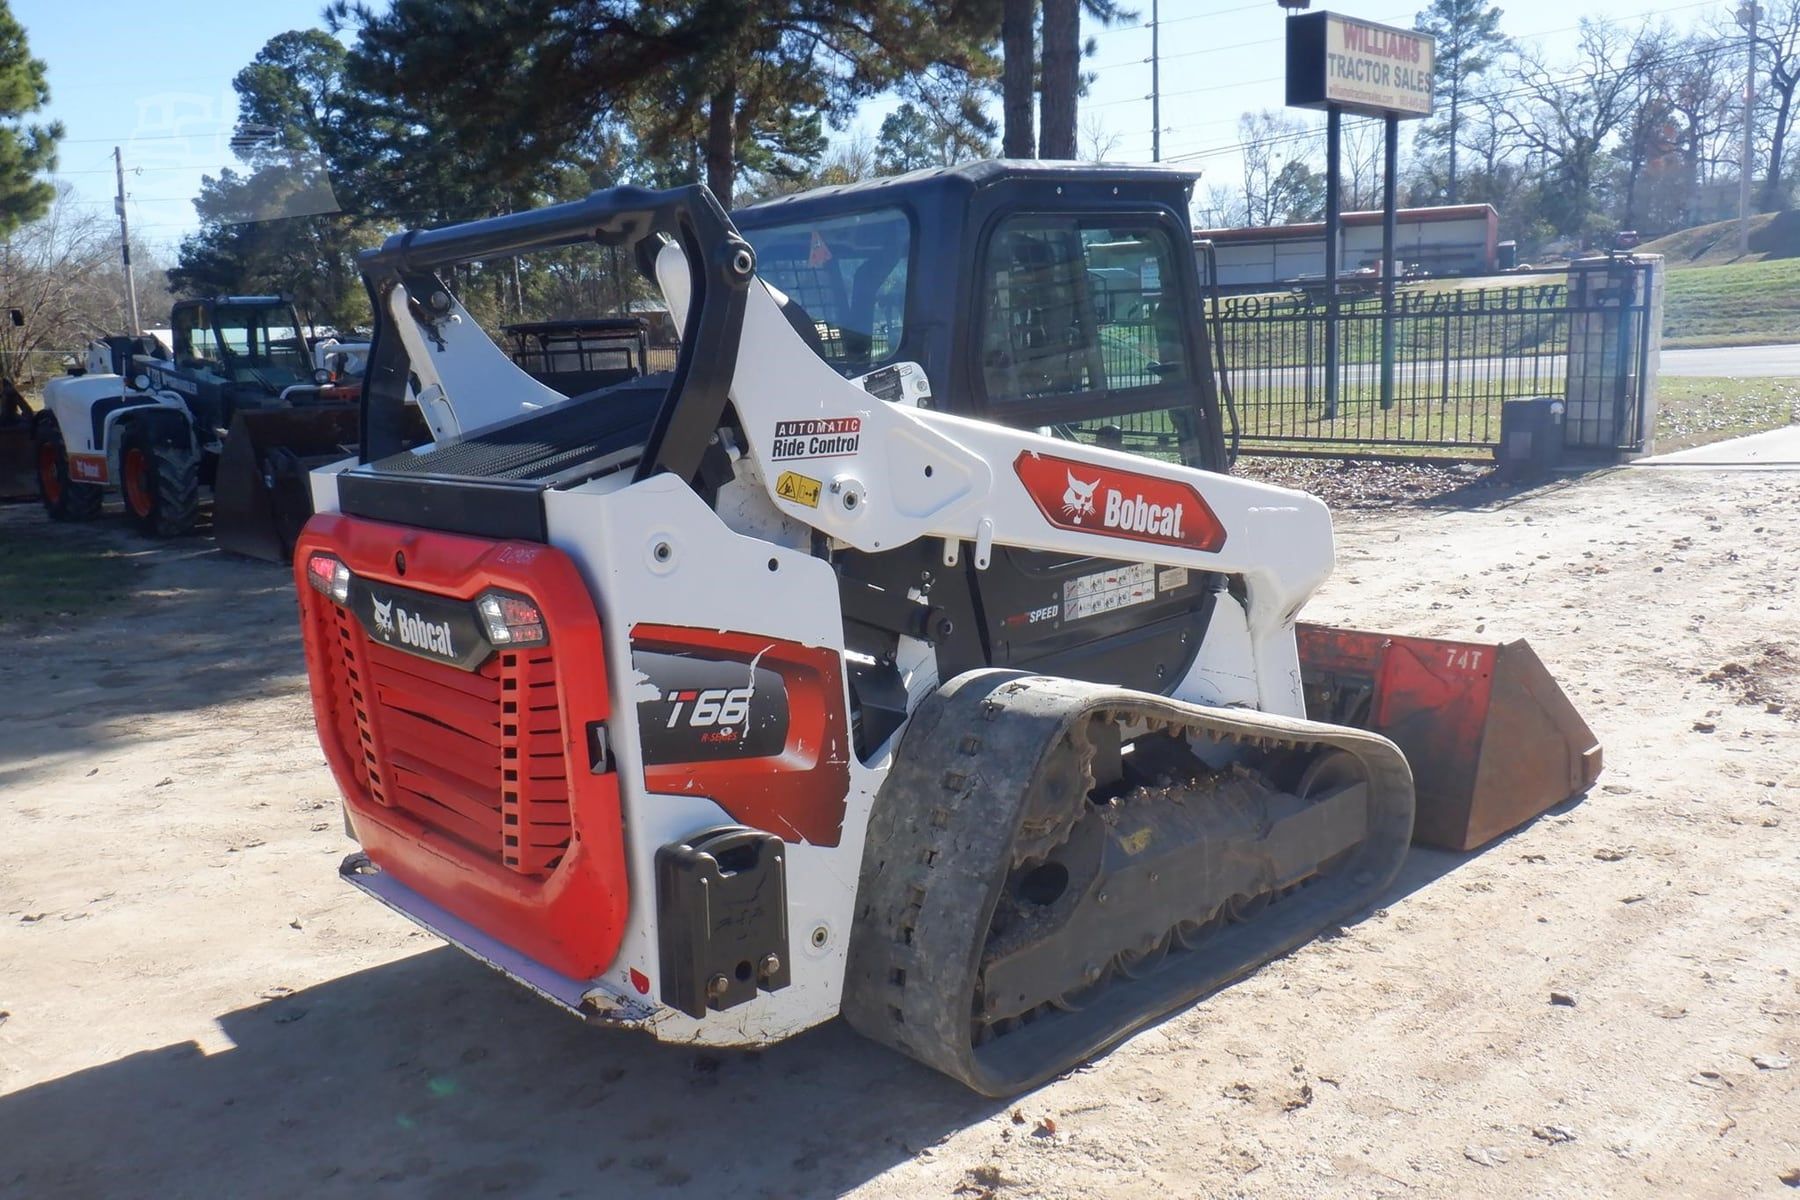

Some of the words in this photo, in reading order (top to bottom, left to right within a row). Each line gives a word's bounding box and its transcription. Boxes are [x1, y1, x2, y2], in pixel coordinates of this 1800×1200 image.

[1343, 23, 1420, 63] WILLIAMS
[1328, 53, 1390, 86] TRACTOR
[1394, 66, 1431, 94] SALES
[772, 438, 805, 457] Ride
[809, 434, 859, 454] Control
[778, 419, 858, 436] AUTOMATIC
[1104, 489, 1183, 538] Bobcat
[396, 608, 454, 657] Bobcat
[1029, 605, 1058, 623] SPEED
[1447, 649, 1482, 669] 74T
[667, 688, 755, 728] T66
